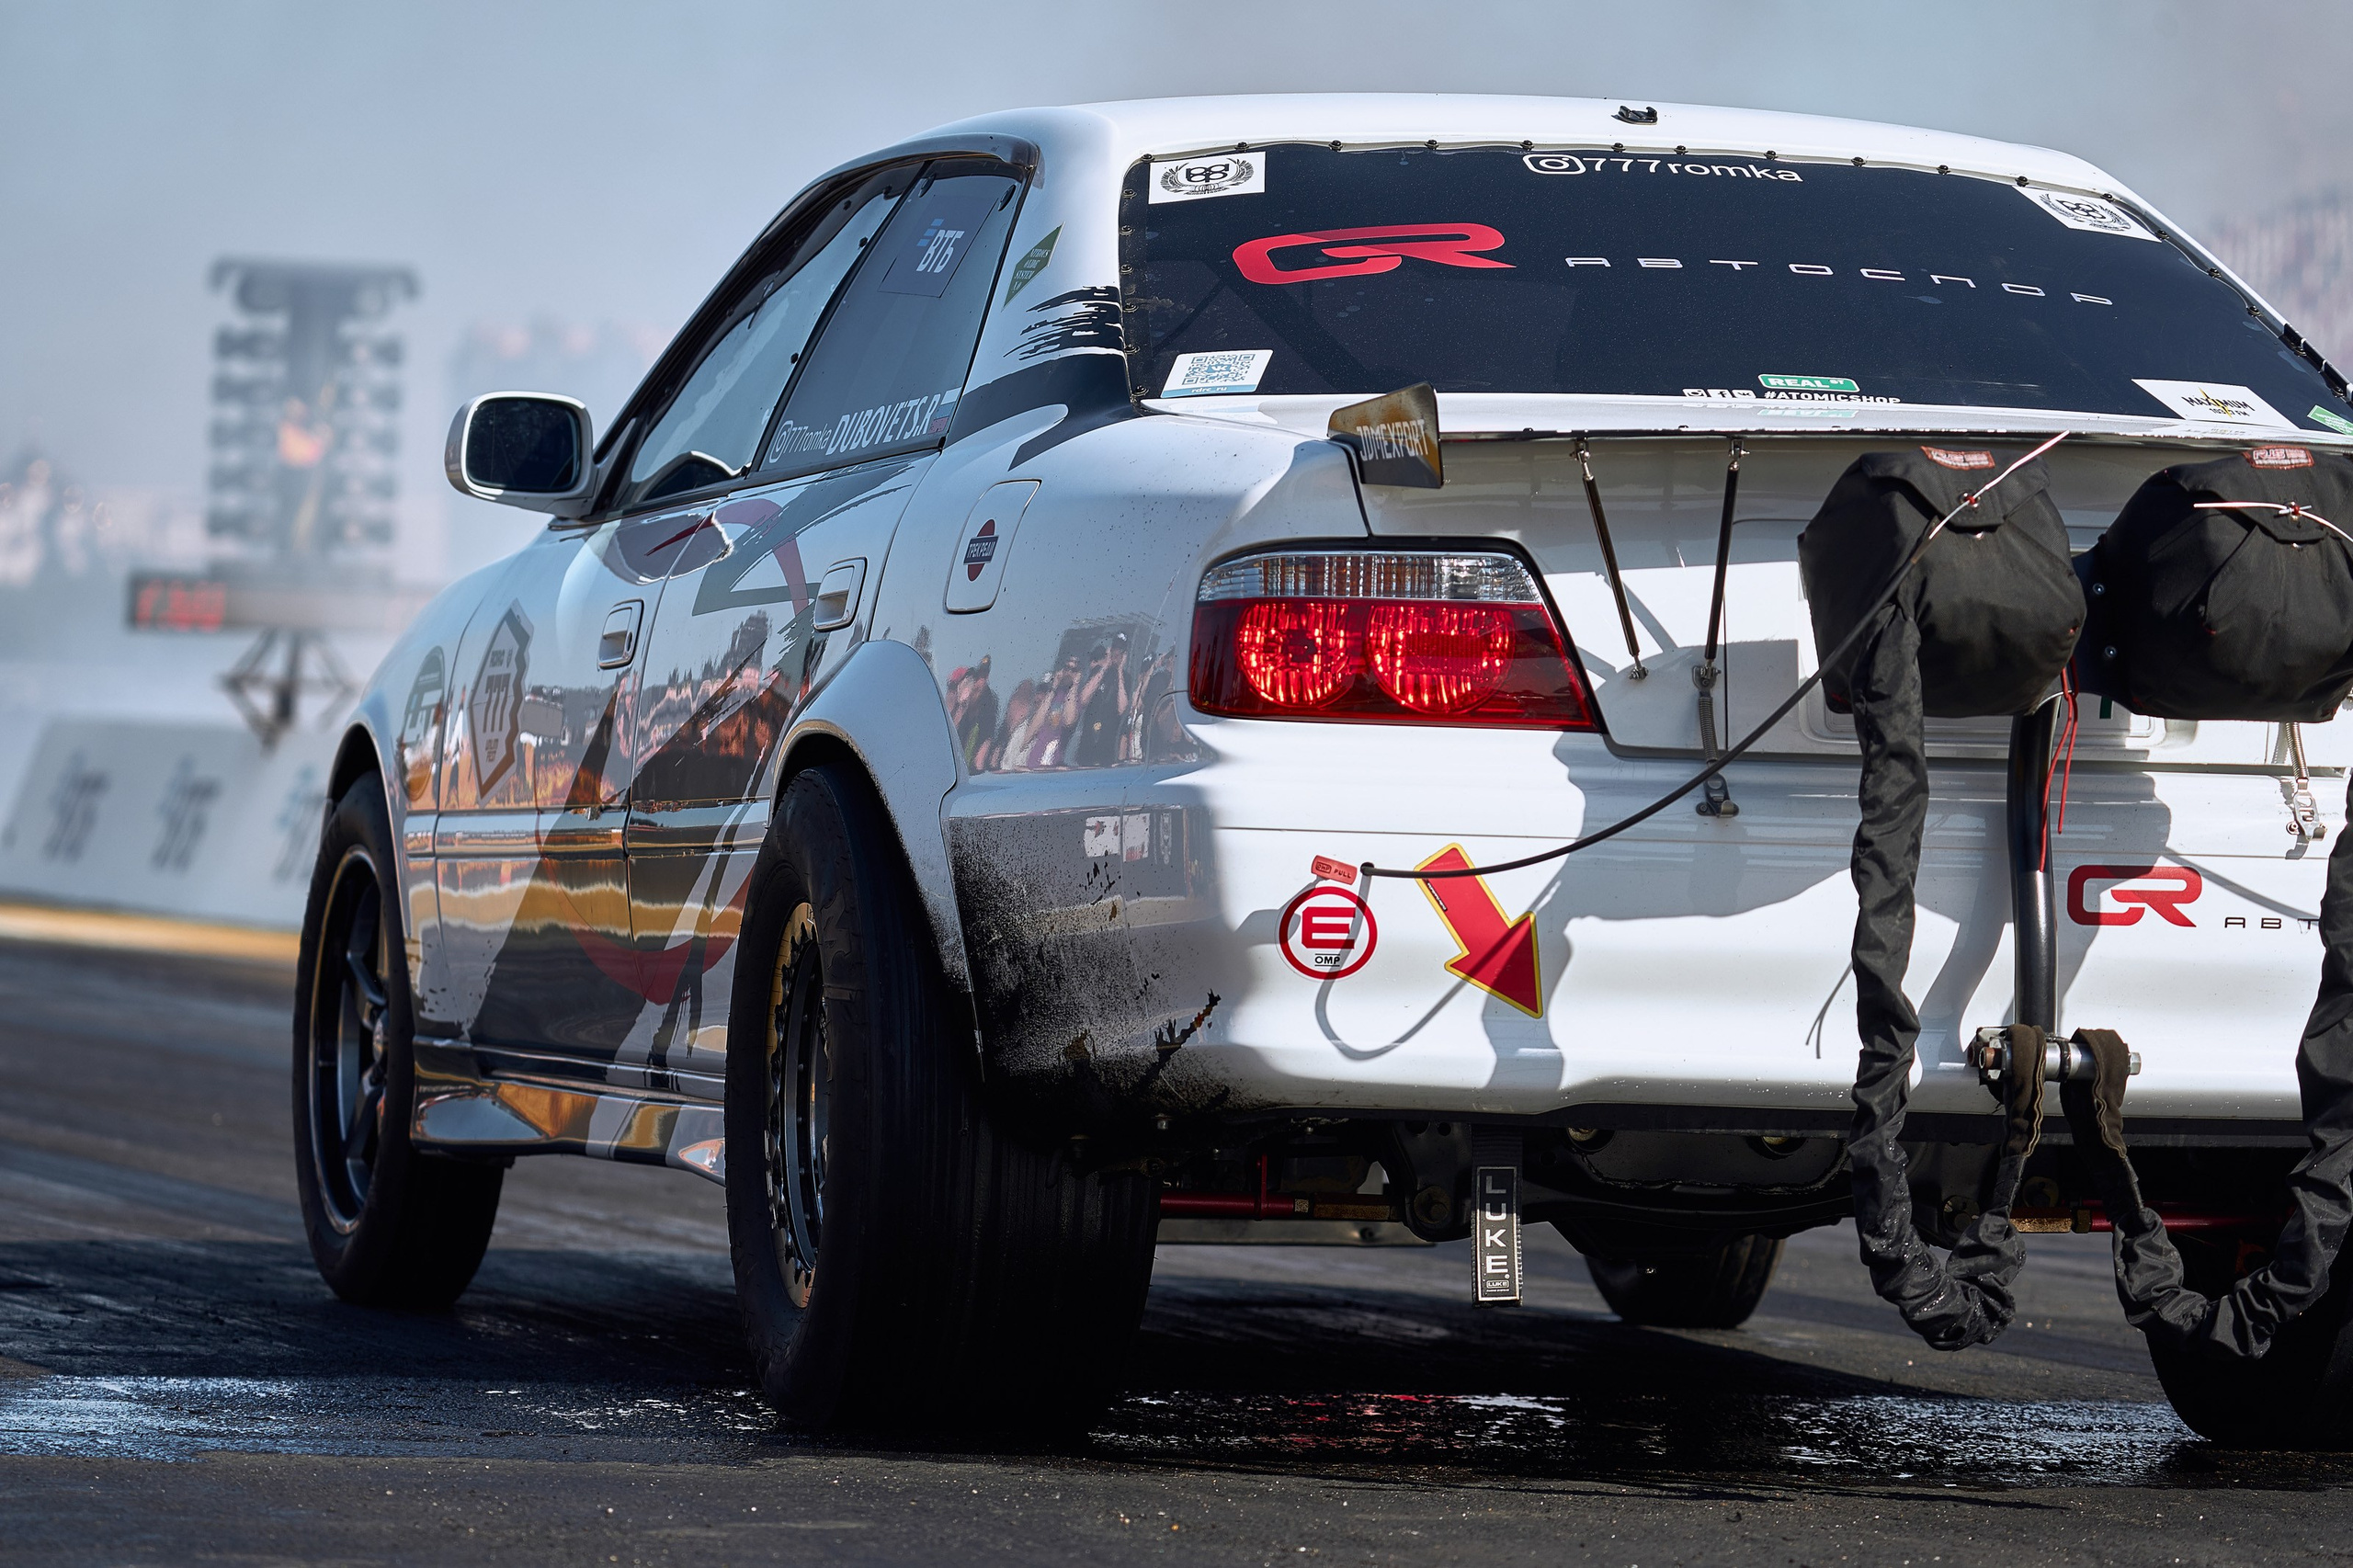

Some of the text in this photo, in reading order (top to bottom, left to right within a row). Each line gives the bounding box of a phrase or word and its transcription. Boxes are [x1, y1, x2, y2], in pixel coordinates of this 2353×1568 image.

[1582, 157, 1803, 182] 777romka
[916, 229, 965, 273] ВТБ
[1767, 377, 1830, 389] REAL
[1764, 391, 1902, 403] #ATOMICSHOP
[2181, 396, 2256, 411] MAXIMUM
[1357, 419, 1428, 461] JDMEXPORT
[1315, 864, 1352, 879] OMP PULL
[1314, 956, 1340, 965] OMP
[1485, 1175, 1508, 1274] LUKE
